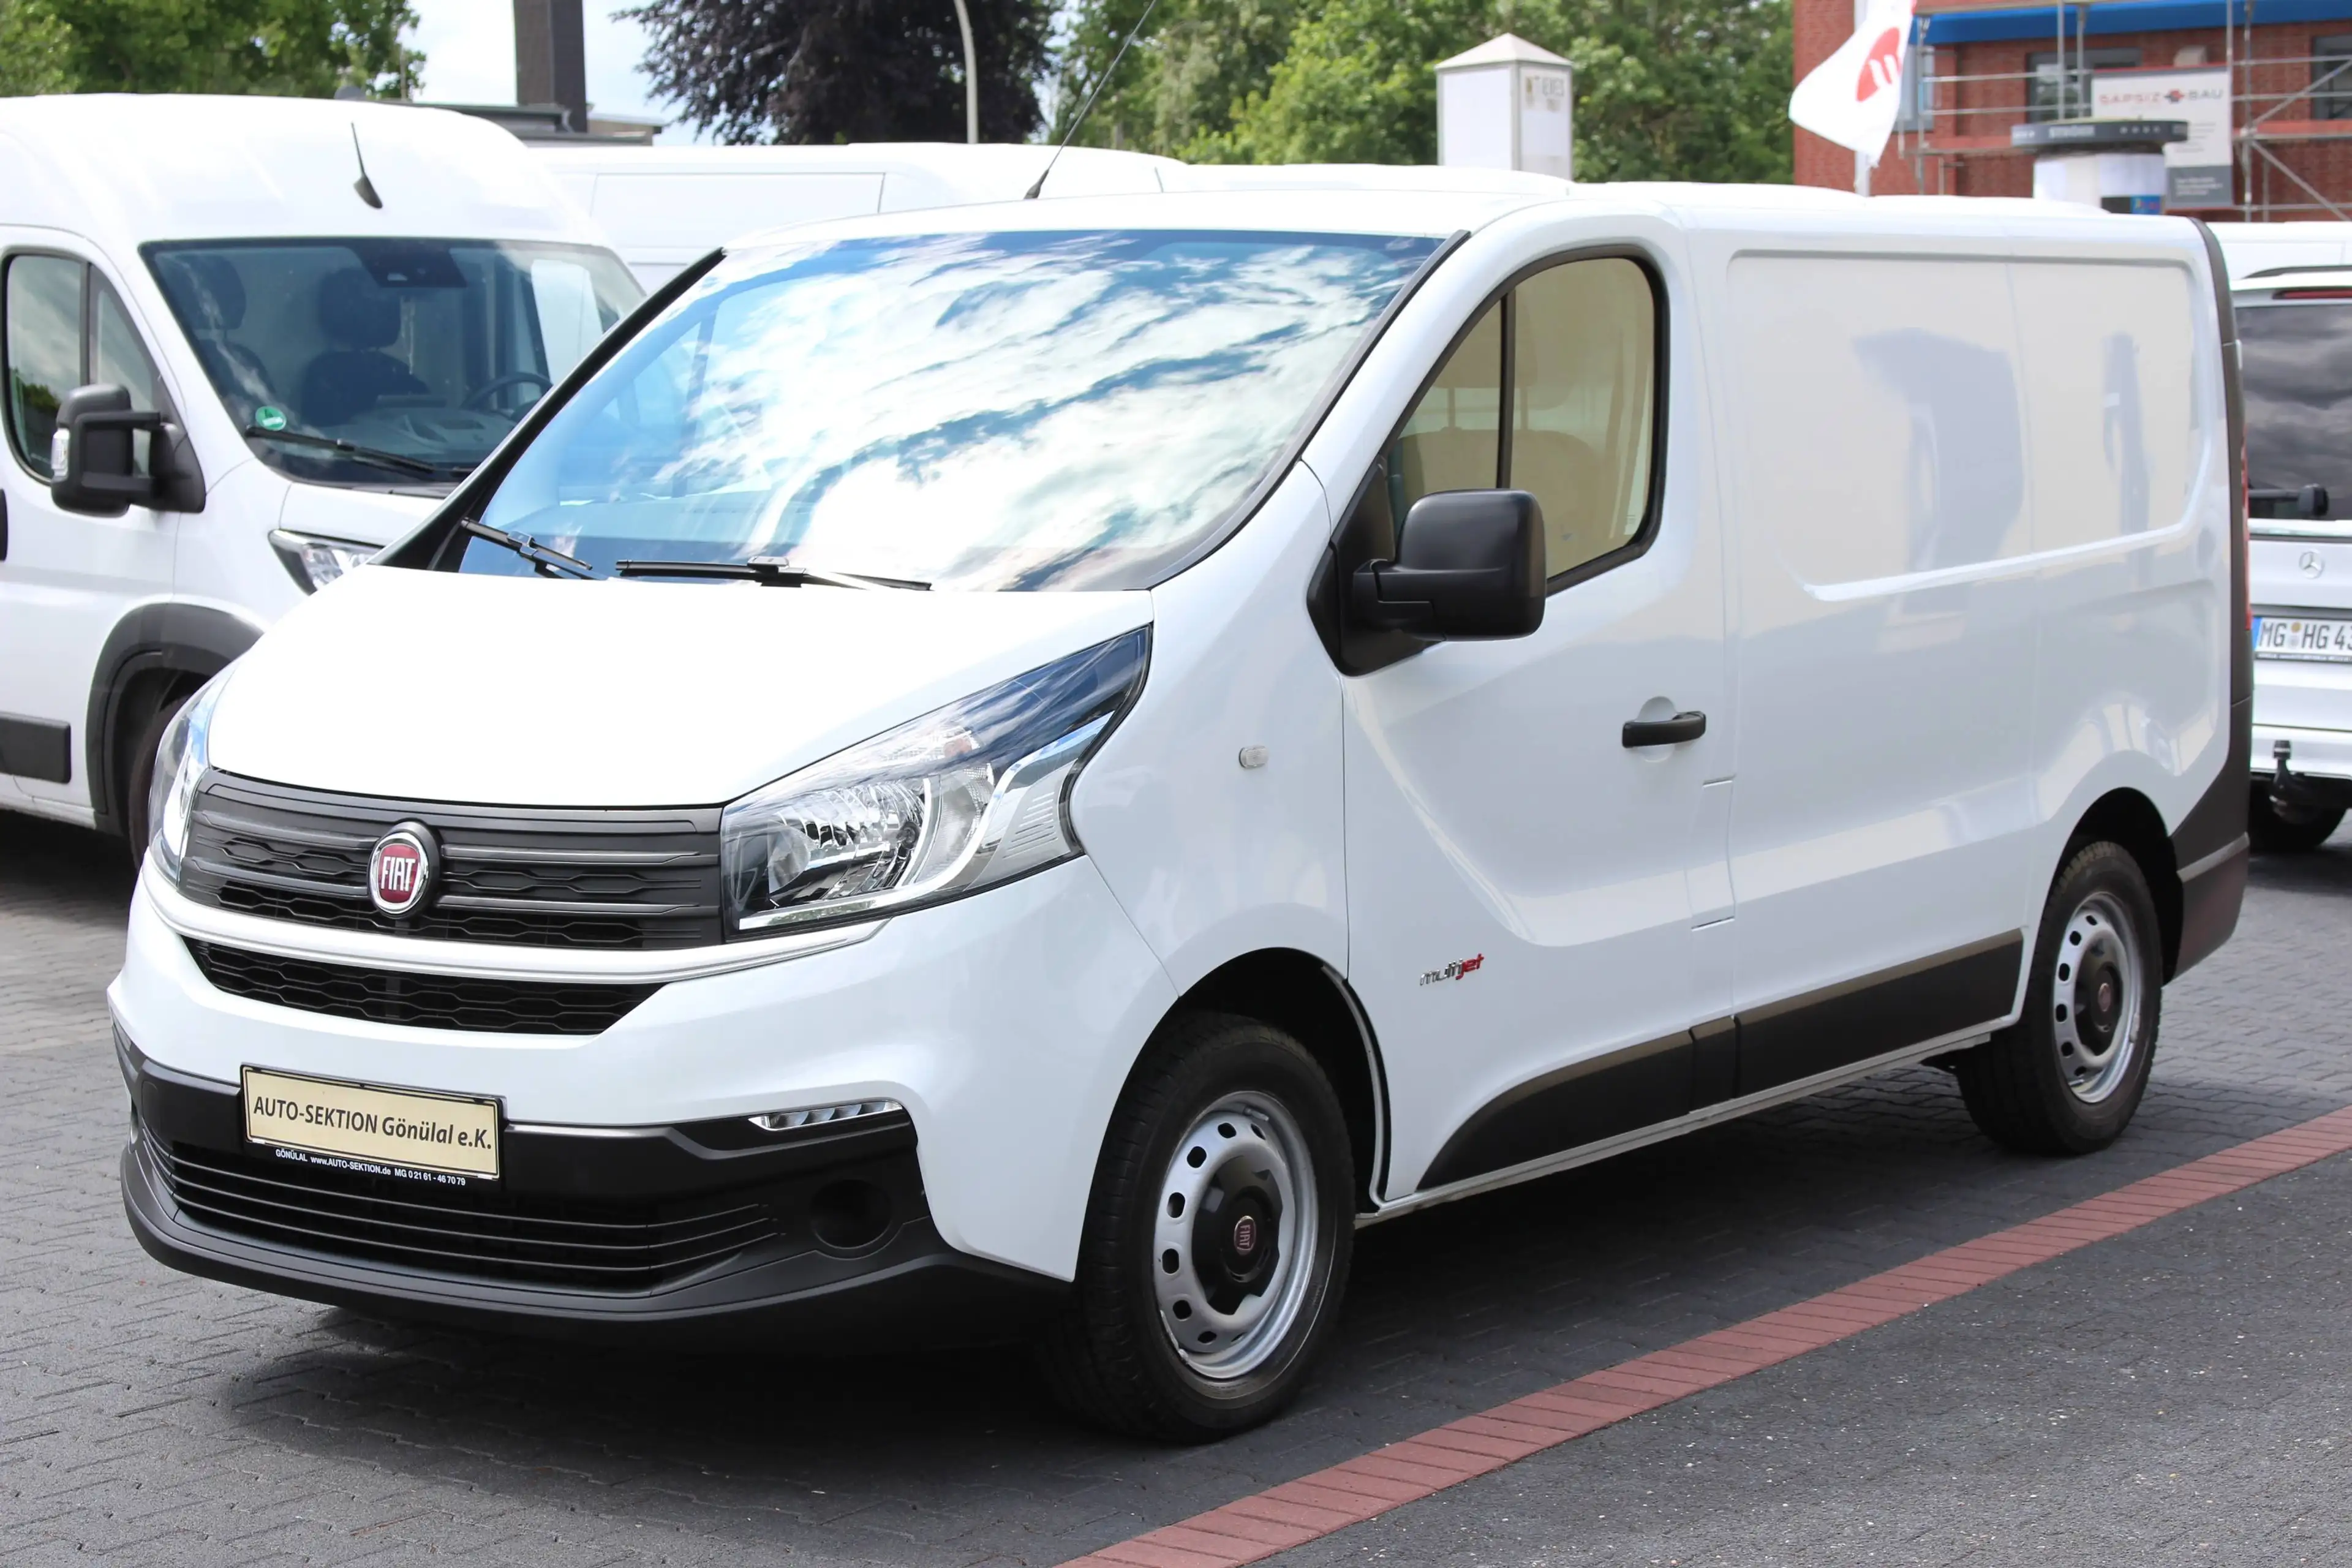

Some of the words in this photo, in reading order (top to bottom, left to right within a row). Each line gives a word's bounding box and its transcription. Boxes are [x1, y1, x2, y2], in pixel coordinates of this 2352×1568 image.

[2189, 89, 2223, 100] BAU
[2260, 622, 2287, 647] MG
[2301, 623, 2330, 649] HG
[381, 856, 416, 891] FIAT
[254, 1096, 378, 1134] AUTO-SEKTION
[382, 1117, 453, 1144] Gönülal
[458, 1128, 492, 1150] e.K.
[276, 1148, 308, 1162] GÖNÜLAL
[311, 1156, 391, 1175] www.AUTO-SEKTION.de
[394, 1169, 407, 1178] MG
[1239, 1224, 1251, 1246] FIAT
